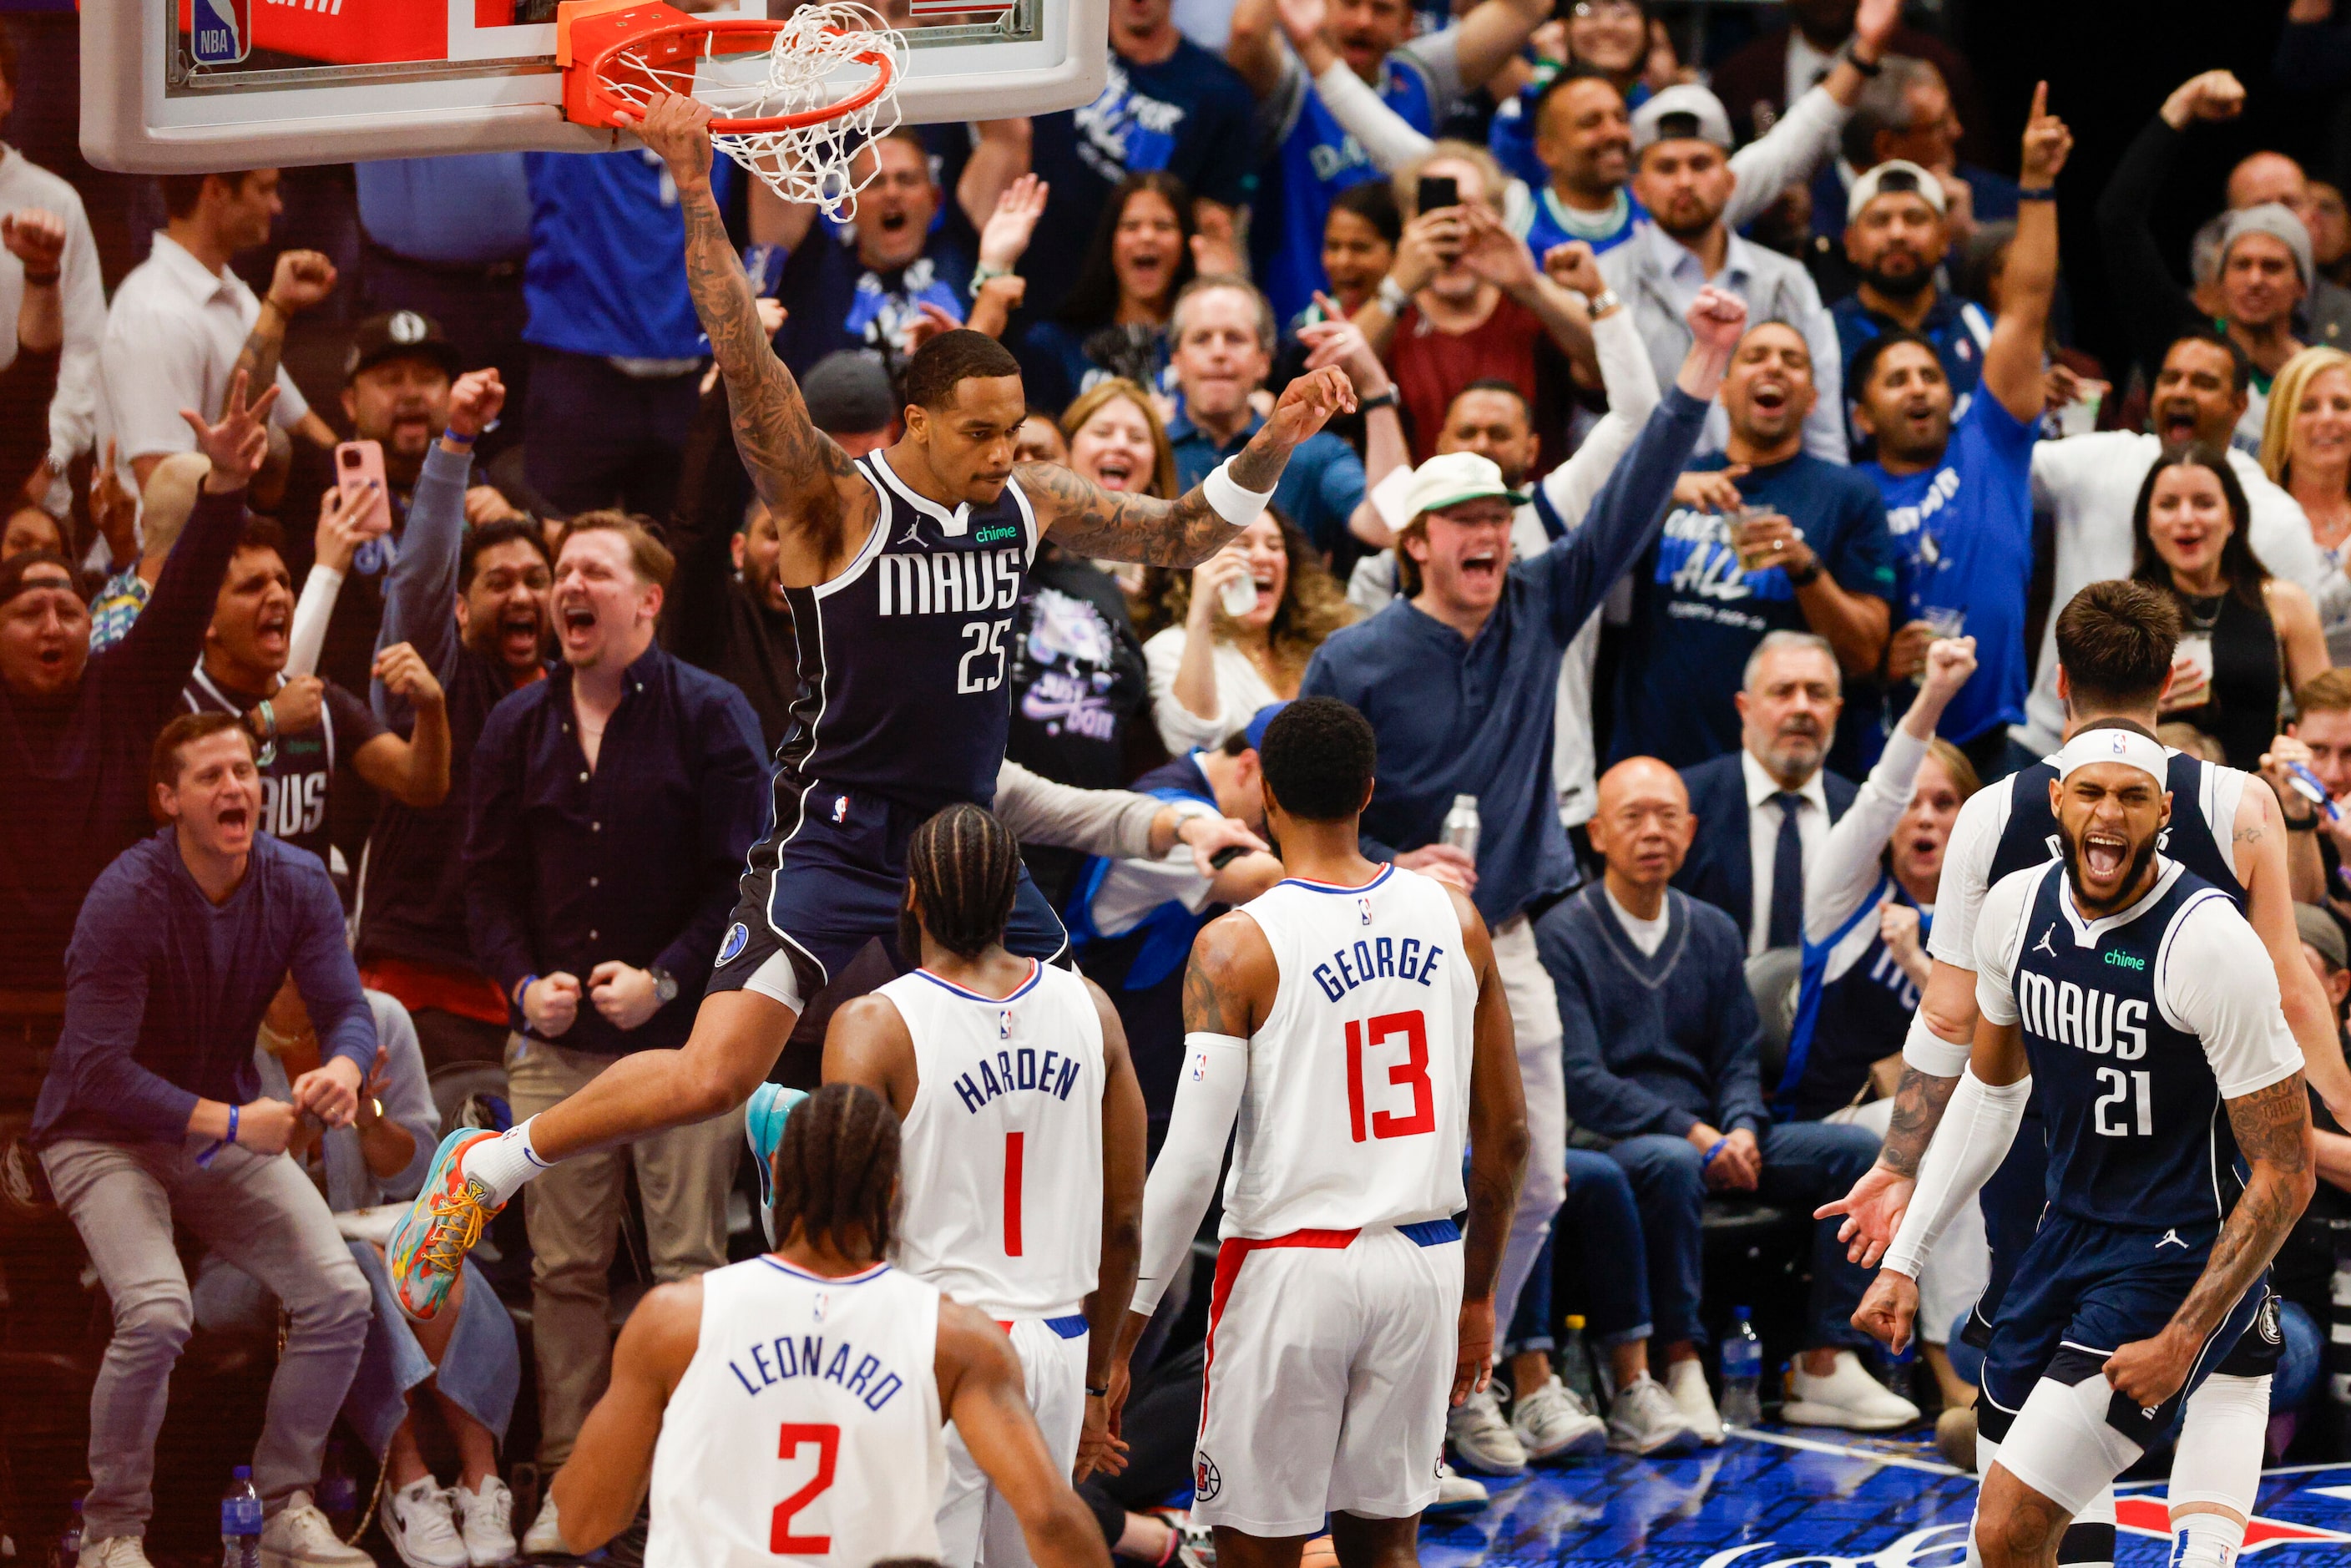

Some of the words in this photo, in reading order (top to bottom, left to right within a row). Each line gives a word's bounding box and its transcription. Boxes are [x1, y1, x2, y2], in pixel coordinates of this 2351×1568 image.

[200, 28, 229, 54] NBA
[975, 524, 1018, 544] chime
[878, 547, 1021, 616] MAVS
[957, 617, 1013, 695] 25
[259, 771, 327, 837] AVS
[1312, 936, 1443, 1004] GEORGE
[2104, 948, 2146, 971] chime
[2019, 969, 2149, 1061] MAVS
[953, 1048, 1081, 1115] HARDEN
[1344, 1009, 1436, 1143] 13
[2094, 1066, 2153, 1137] 21
[1004, 1131, 1024, 1257] 1
[728, 1335, 903, 1413] LEONARD
[769, 1422, 842, 1555] 2
